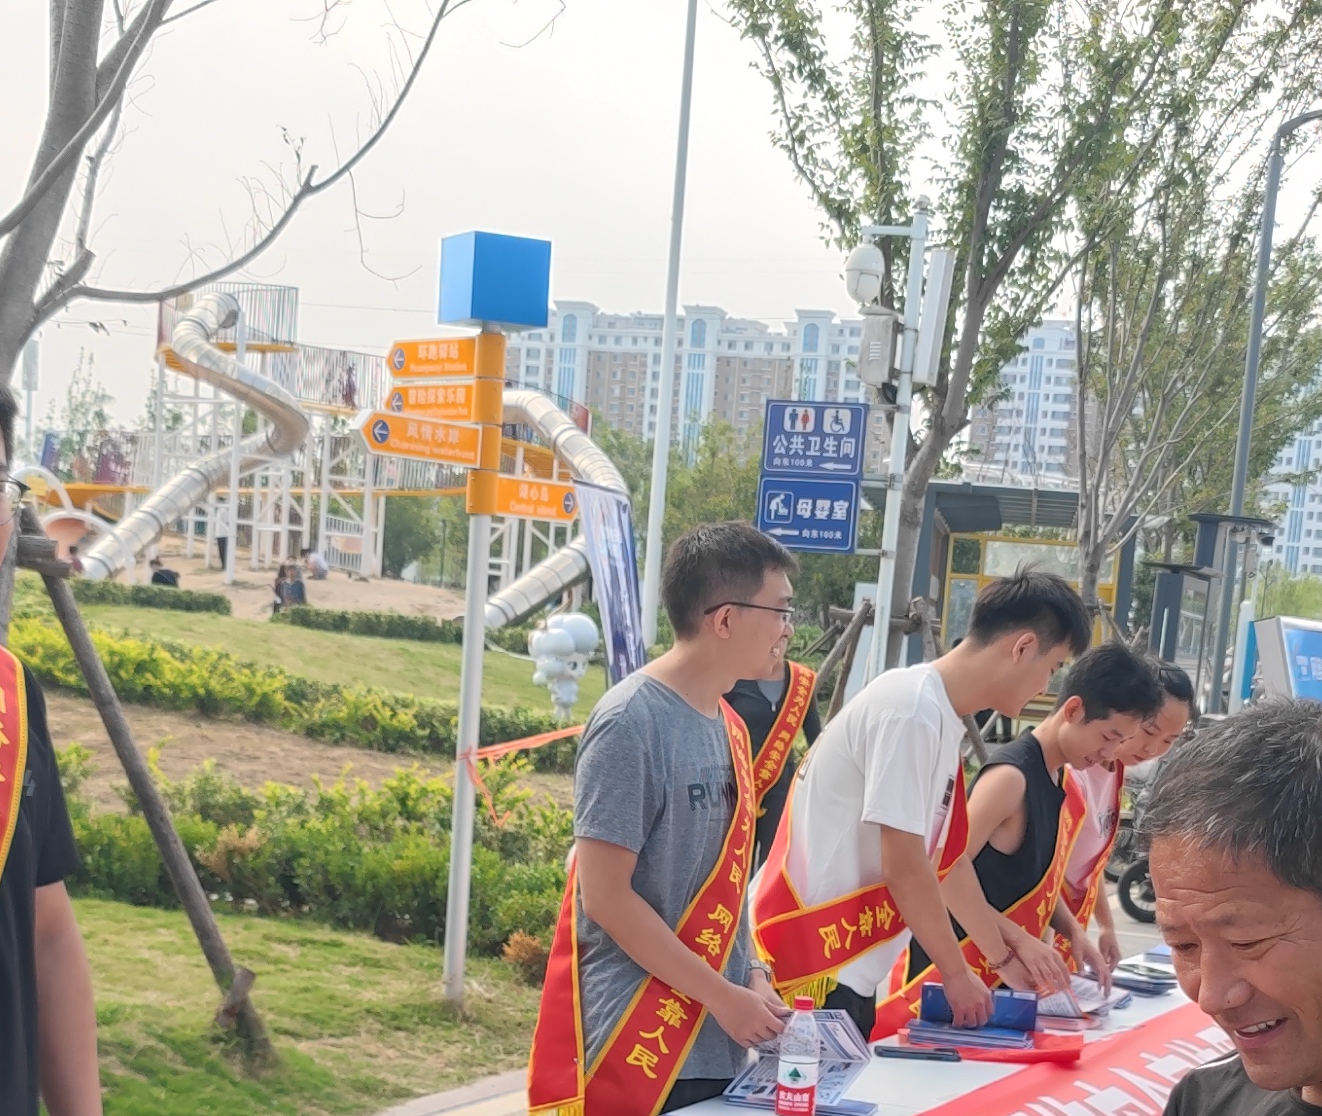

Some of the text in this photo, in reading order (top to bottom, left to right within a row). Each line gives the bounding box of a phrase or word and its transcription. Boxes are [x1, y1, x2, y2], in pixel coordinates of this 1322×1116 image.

[772, 434, 856, 459] 公共卫生间
[796, 499, 850, 521] 母婴室
[818, 900, 905, 959] 全靠人民
[625, 903, 733, 1079] 网络靠人民
